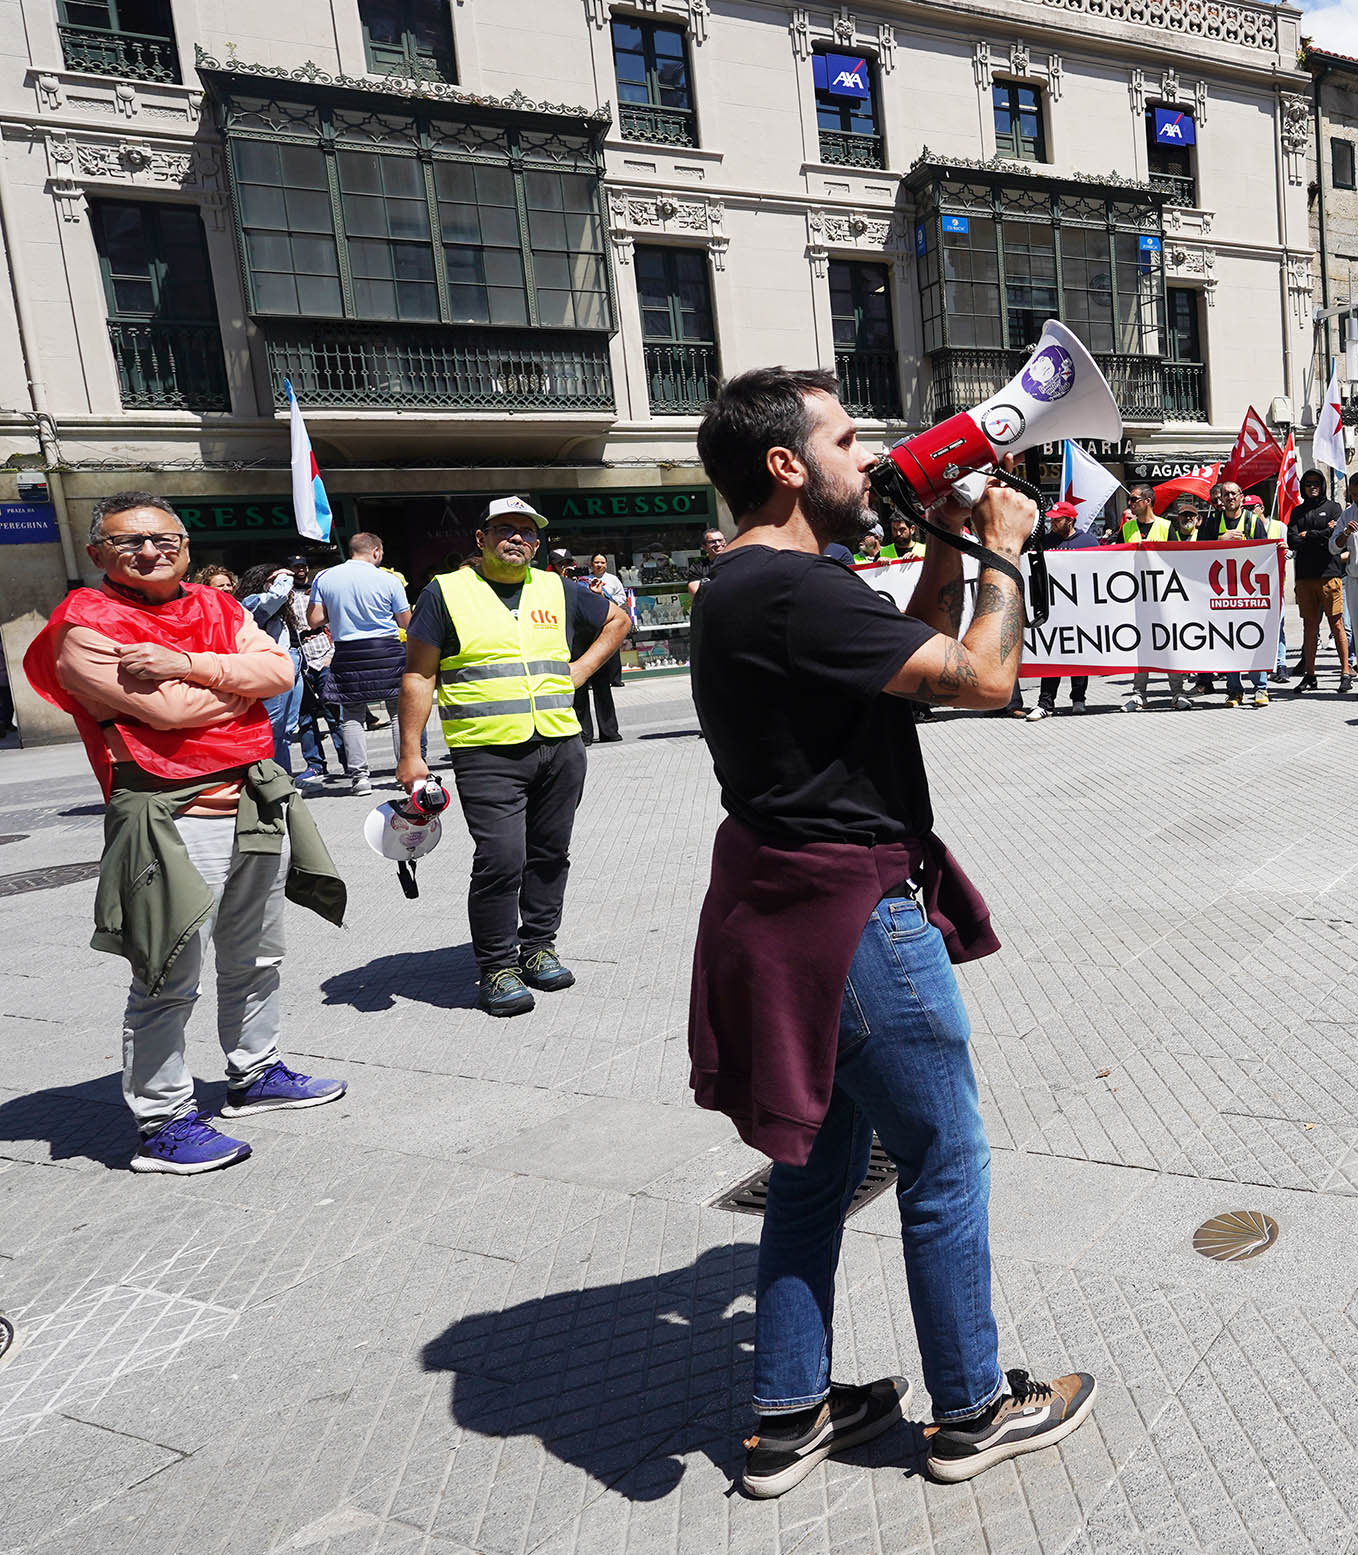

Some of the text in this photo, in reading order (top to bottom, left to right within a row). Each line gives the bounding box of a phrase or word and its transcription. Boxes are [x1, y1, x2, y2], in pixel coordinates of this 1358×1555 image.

[832, 71, 864, 89] AXA
[1159, 123, 1183, 138] AXA
[177, 506, 290, 528] RESS
[562, 495, 691, 517] ARESSO
[1093, 568, 1190, 604] LOITA
[1208, 559, 1270, 597] CIG
[1211, 599, 1269, 609] INDUSTRIA
[531, 609, 558, 625] CIG
[1024, 621, 1265, 656] NVENIO DIGNO
